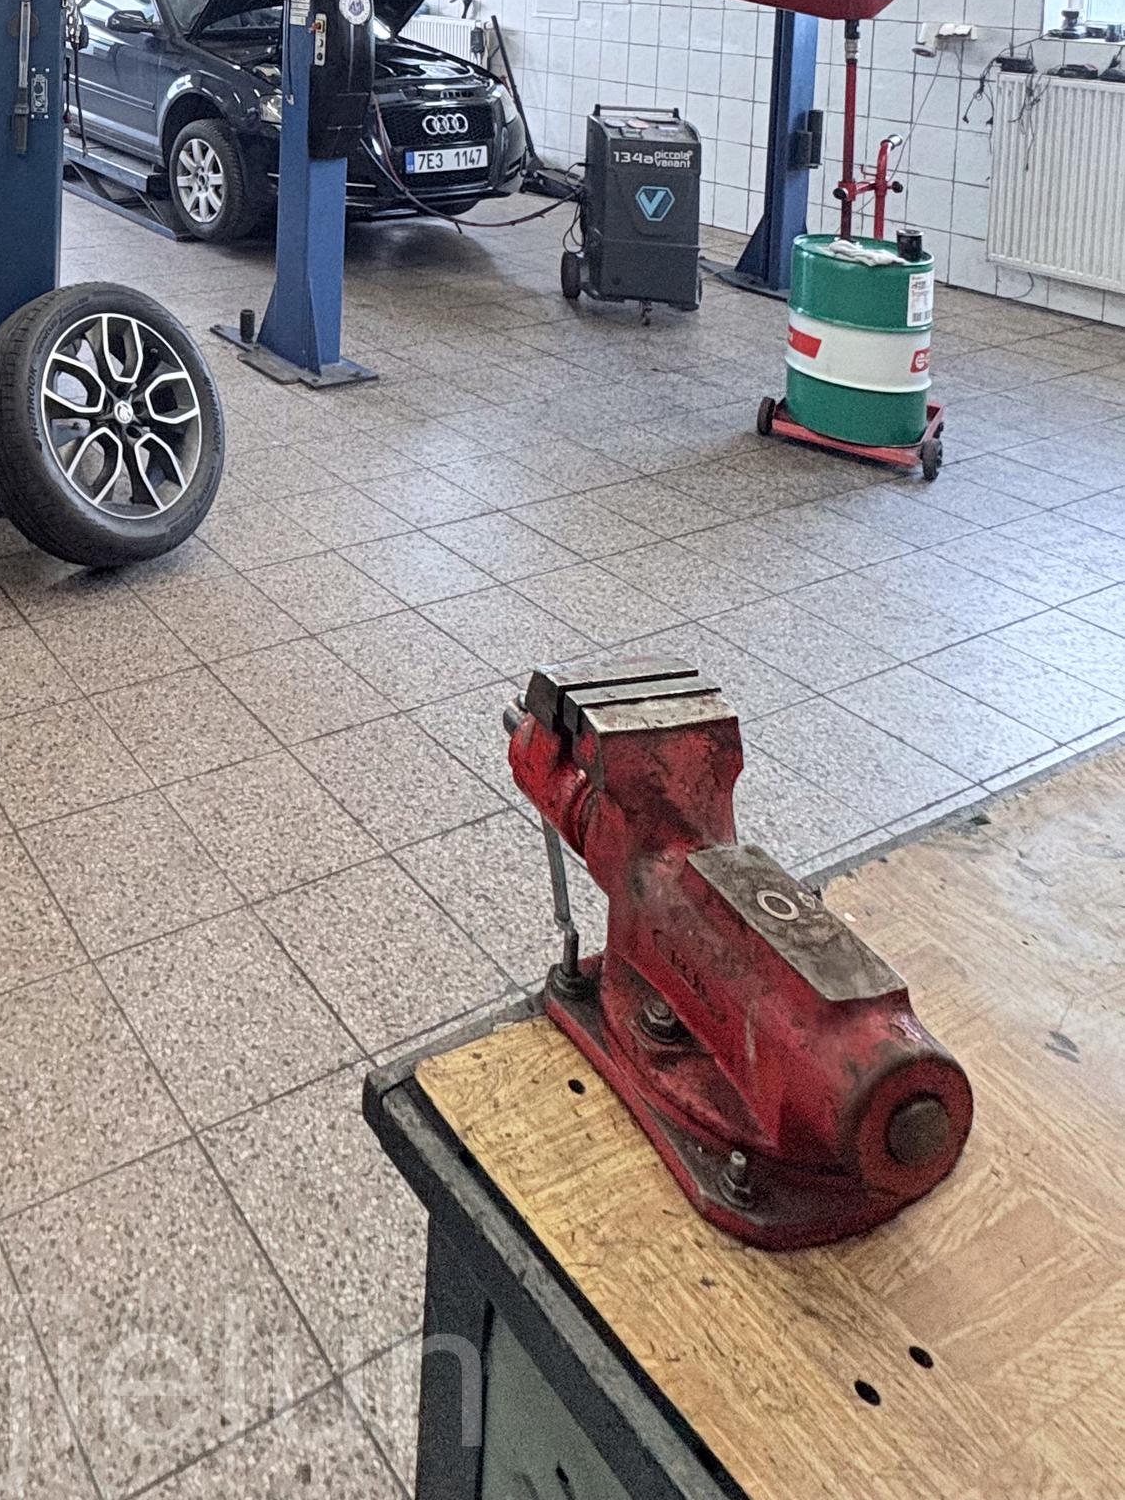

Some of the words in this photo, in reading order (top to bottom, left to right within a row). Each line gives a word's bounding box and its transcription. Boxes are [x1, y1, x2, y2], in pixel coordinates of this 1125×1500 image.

[418, 153, 443, 171] 7E3
[454, 148, 482, 167] 1147
[613, 151, 654, 165] 134a
